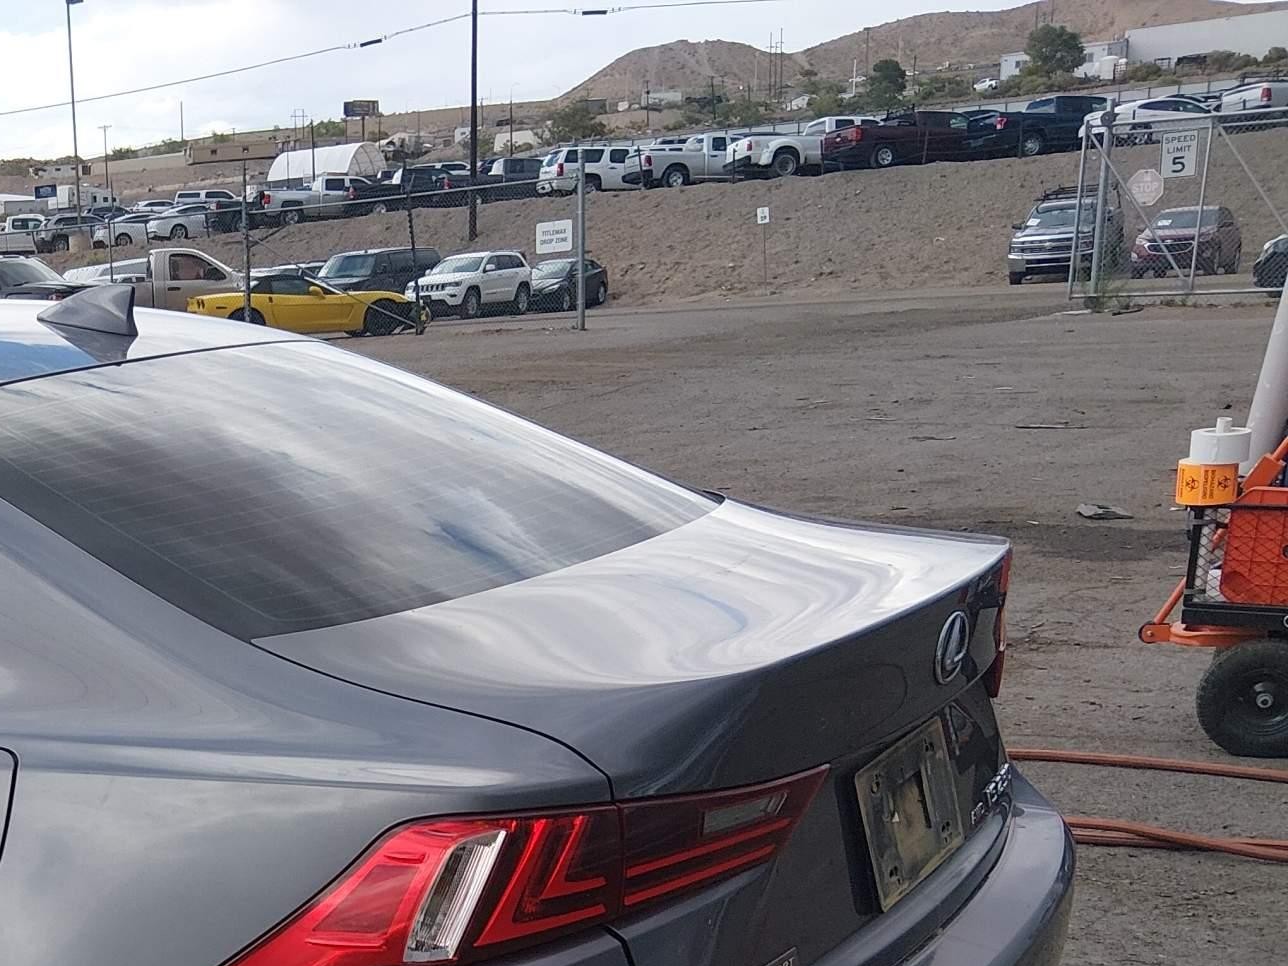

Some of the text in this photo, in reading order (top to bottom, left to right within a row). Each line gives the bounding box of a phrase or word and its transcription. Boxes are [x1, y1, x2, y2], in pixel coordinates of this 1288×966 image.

[1164, 134, 1196, 145] SPEED
[1167, 144, 1192, 154] LIMIT
[1171, 155, 1186, 173] 5
[1132, 182, 1159, 194] STOP
